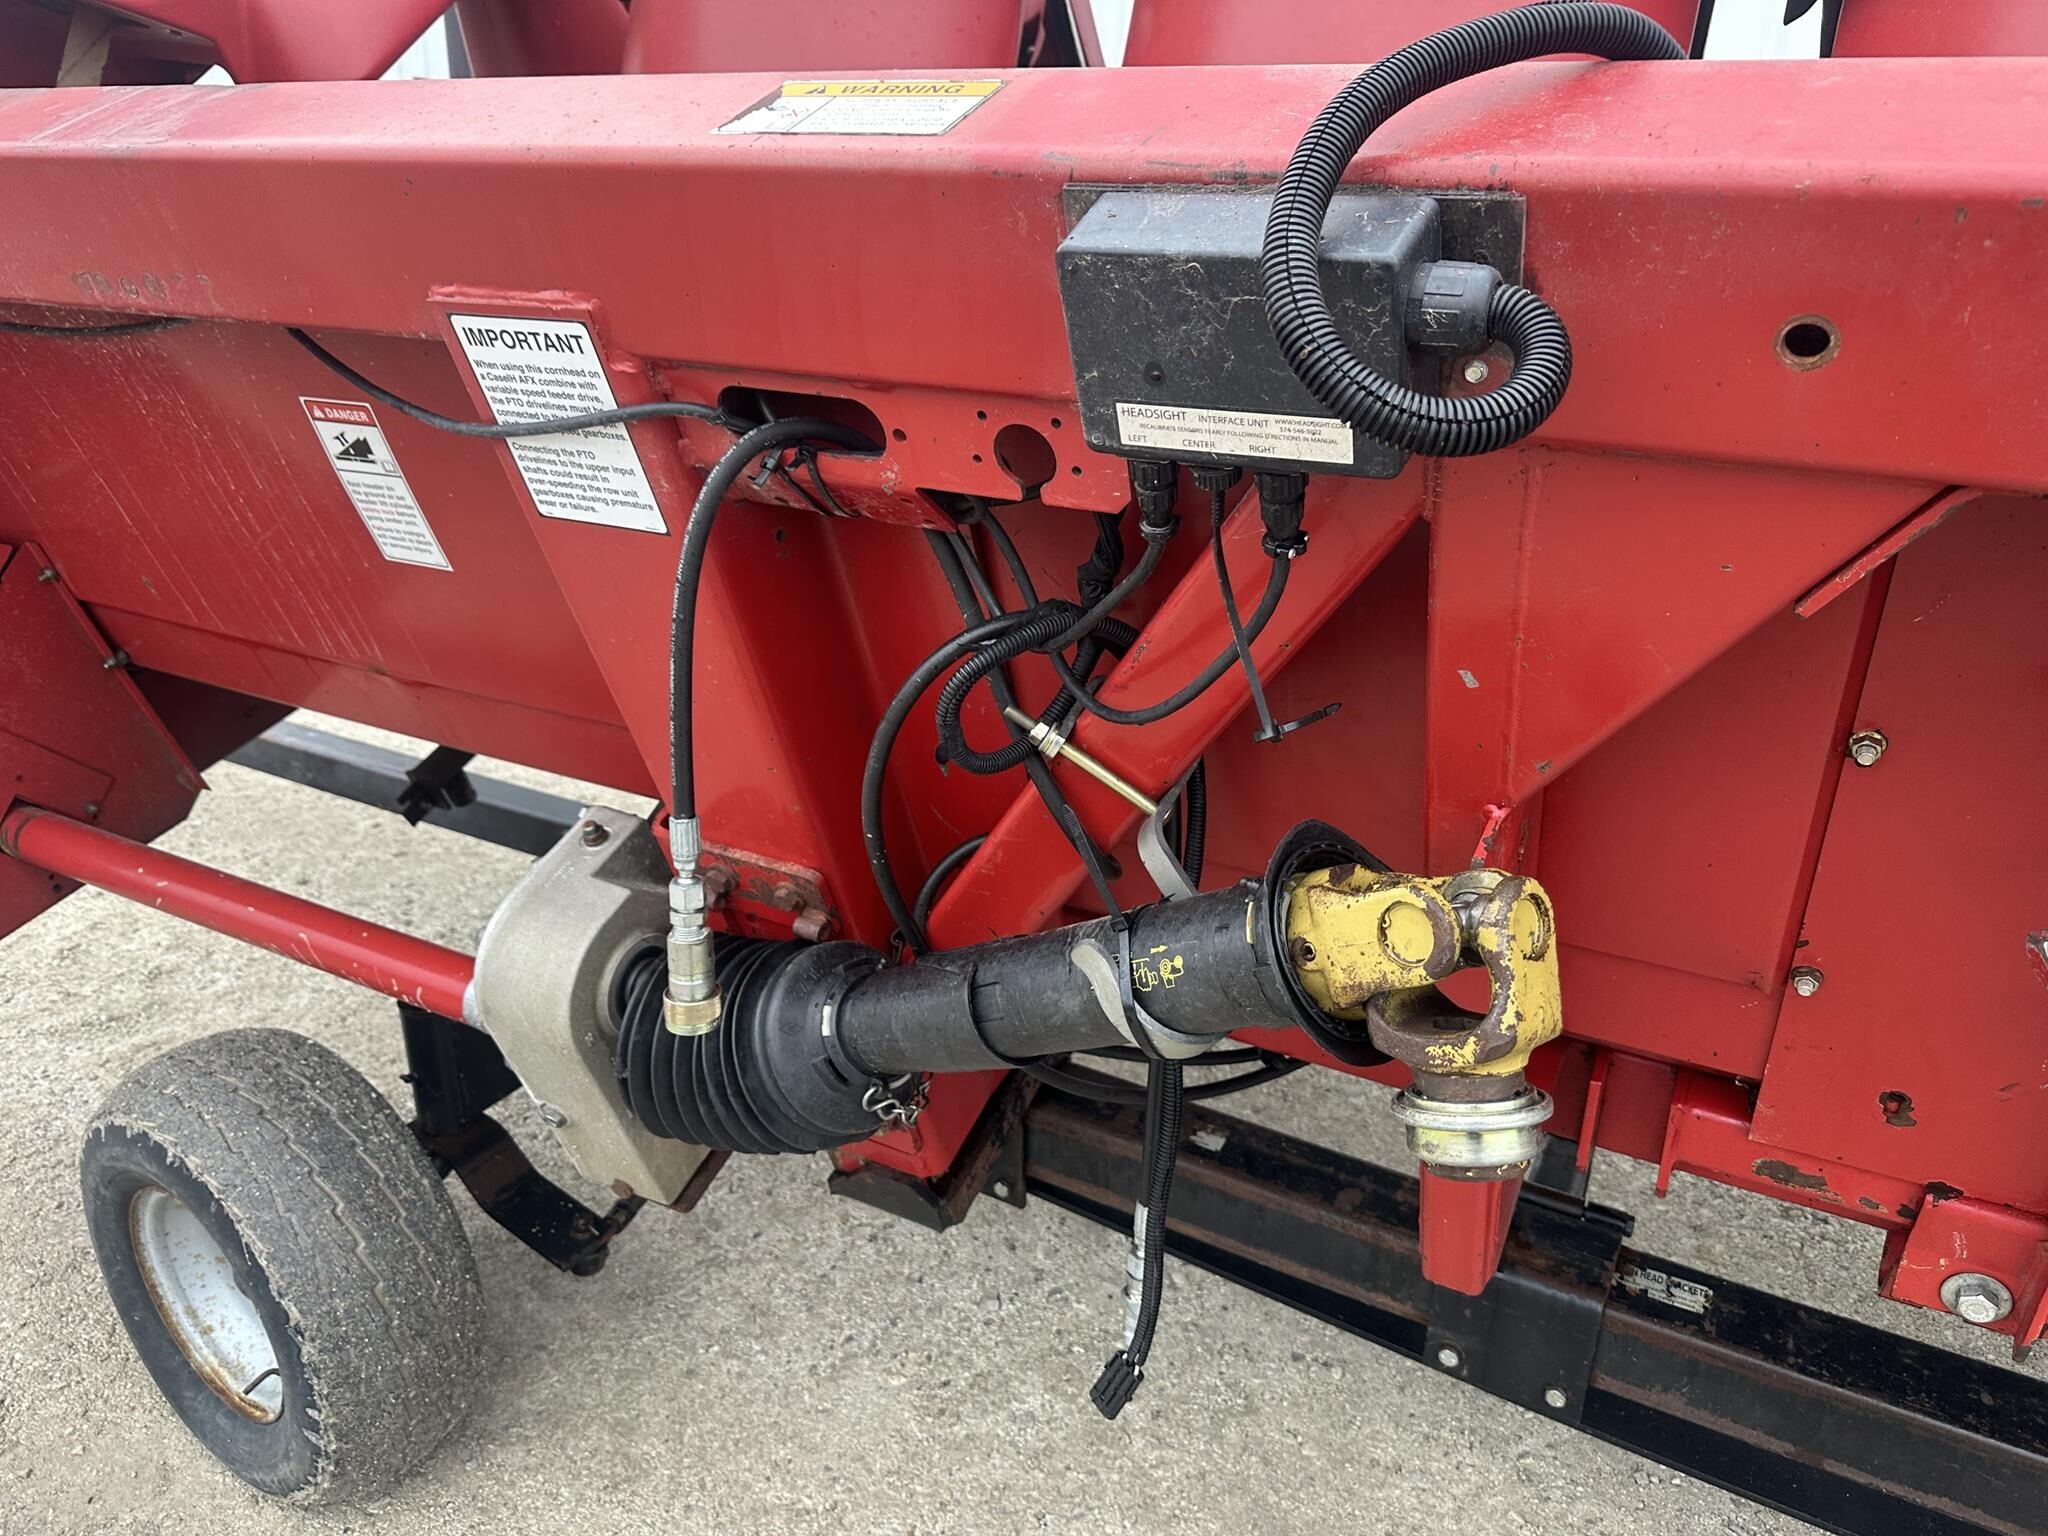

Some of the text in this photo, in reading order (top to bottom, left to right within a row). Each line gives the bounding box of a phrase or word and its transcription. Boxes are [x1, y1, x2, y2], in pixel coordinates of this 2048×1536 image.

[841, 84, 965, 94] WARNING
[462, 327, 584, 354] IMPORTANT
[473, 359, 600, 379] When using this cornhead on
[480, 373, 486, 381] a
[518, 376, 537, 385] AFX
[538, 378, 576, 389] combine
[577, 381, 598, 391] with
[485, 384, 604, 405] variable speed feeder drive,
[490, 395, 505, 405] the
[505, 397, 524, 407] PTO
[526, 400, 568, 412] drivelines
[325, 408, 369, 422] DANGER
[497, 409, 541, 420] connected
[541, 413, 551, 422] to
[1121, 407, 1187, 421] HEADSIGHT
[1198, 415, 1246, 426] INTERFACE
[1247, 419, 1269, 428] UNIT
[582, 429, 628, 441] gearboxes.
[1139, 423, 1176, 432] RECALIBRATE
[1204, 428, 1226, 436] YEARLY
[1227, 430, 1263, 439] FOLLOWING
[512, 442, 596, 460] Connecting the PTO
[1128, 434, 1276, 454] LEFT CENTER RIGHT
[518, 454, 558, 466] drivelines
[569, 460, 584, 469] the
[585, 463, 610, 473] upper
[611, 465, 636, 476] input
[523, 466, 610, 483] shafts could result in
[528, 477, 640, 499] over-speeding the row unit
[533, 488, 654, 511] gearboxes causing premature
[537, 499, 557, 507] wear
[568, 502, 599, 513] failure.
